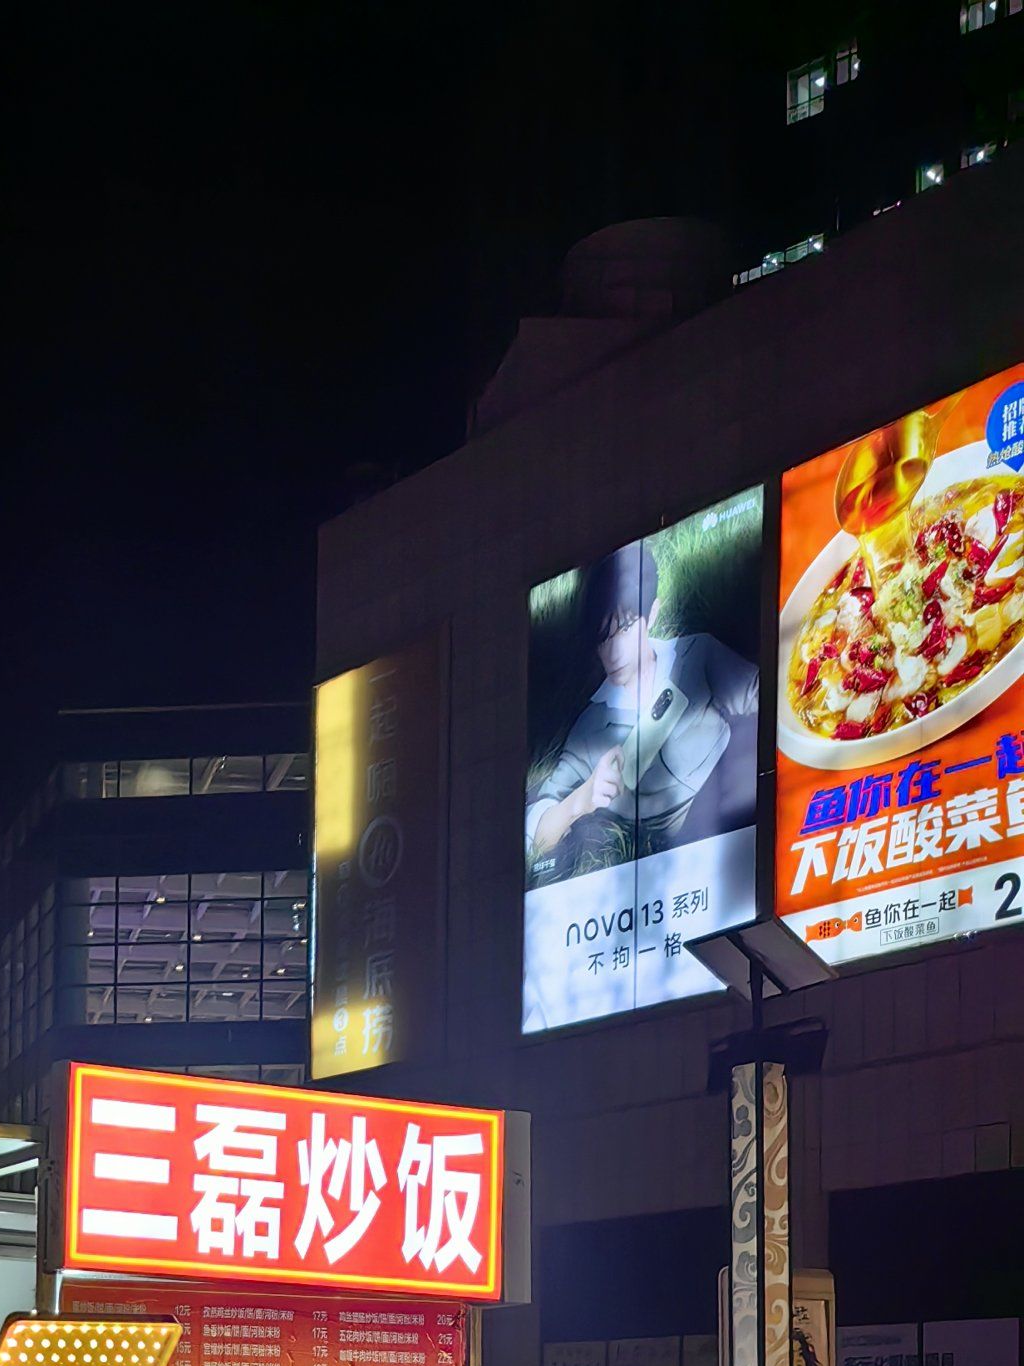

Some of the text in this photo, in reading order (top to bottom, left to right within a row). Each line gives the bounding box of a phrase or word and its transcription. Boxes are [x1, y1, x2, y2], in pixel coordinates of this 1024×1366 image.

[800, 731, 1024, 836] 鱼你在一起
[566, 886, 709, 947] nova 13 系列
[864, 888, 957, 930] 鱼你在一起
[588, 932, 682, 976] 不拘一格
[82, 1098, 484, 1275] 三磊炒饭
